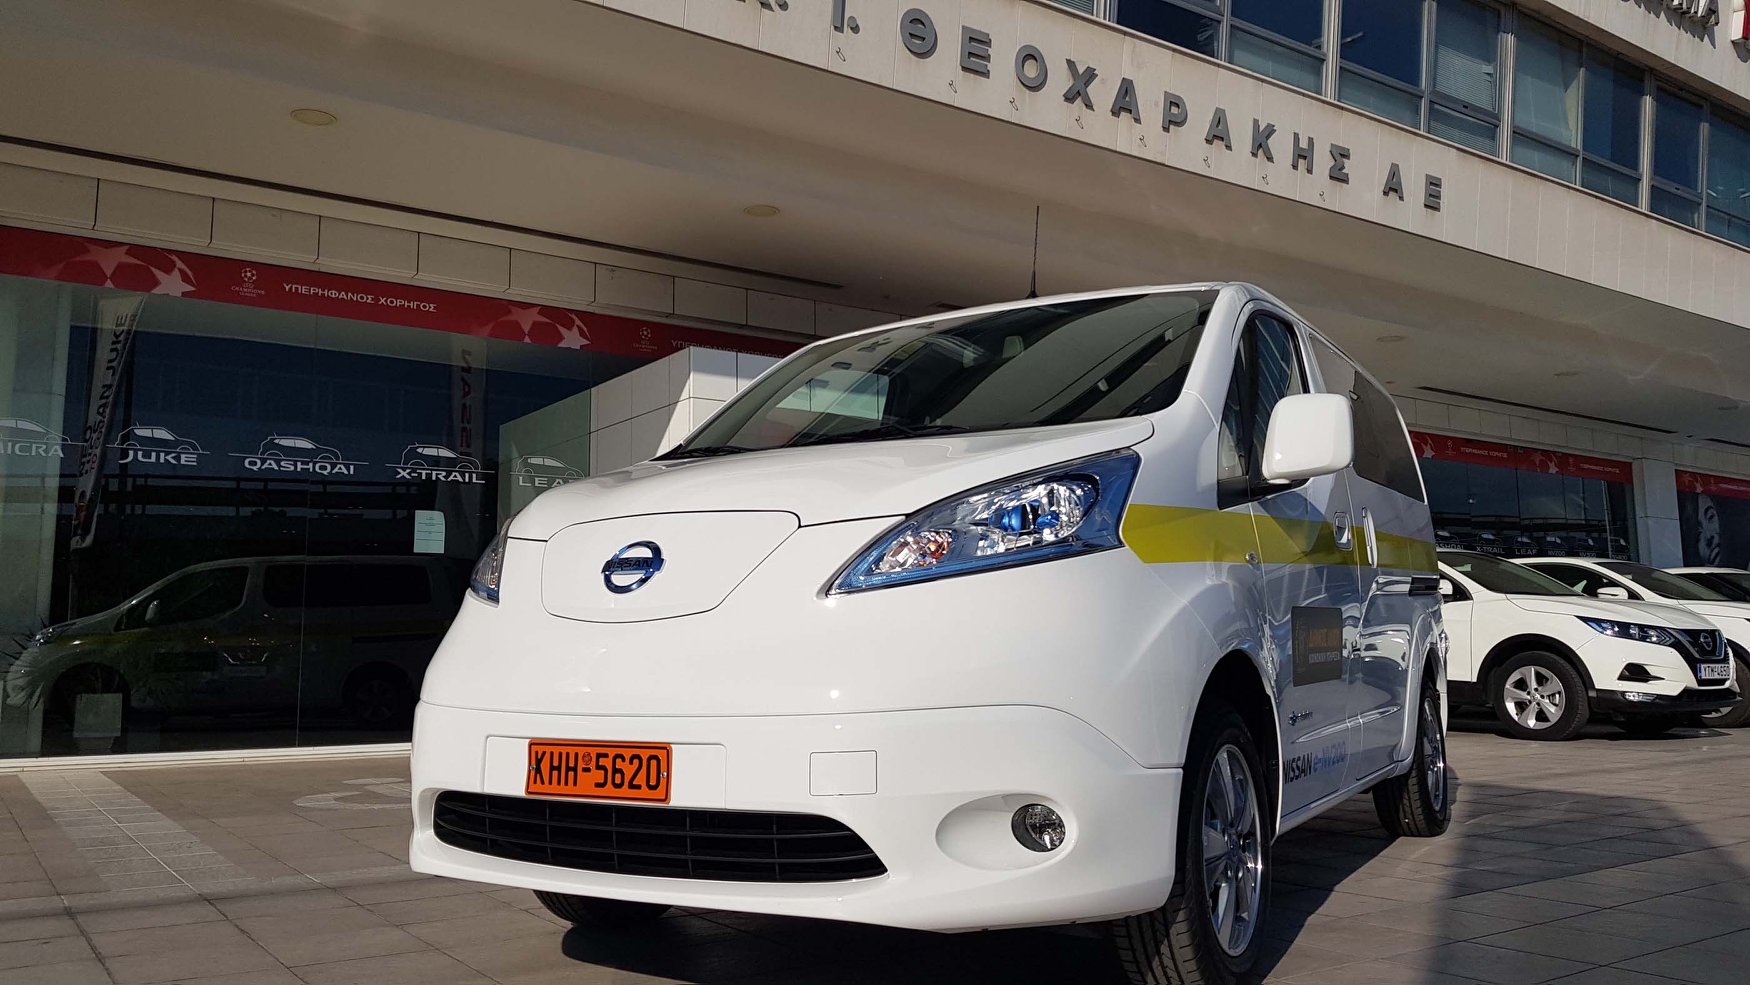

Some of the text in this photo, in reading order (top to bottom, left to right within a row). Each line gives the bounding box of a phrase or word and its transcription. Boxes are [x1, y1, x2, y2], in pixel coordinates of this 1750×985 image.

[900, 8, 1351, 184] ΘΕΟΧΑΡΑΚΗΣ
[1382, 162, 1442, 212] ΑΕ
[283, 283, 437, 312] ΥΠΕΡΗΦΑΝΟΣ ΧΟΡΗΓΟΣ
[105, 312, 129, 377] JUKE
[118, 451, 198, 466] JUKE
[243, 457, 355, 475] QASHQAI
[395, 468, 486, 483] X-TRAIL
[518, 476, 575, 488] LEA
[1475, 545, 1506, 554] X-TRAIL
[1514, 548, 1538, 556] LEAF
[605, 557, 654, 571] NISSAN
[532, 749, 662, 791] KHH-5620
[1283, 751, 1313, 785] NISSAN
